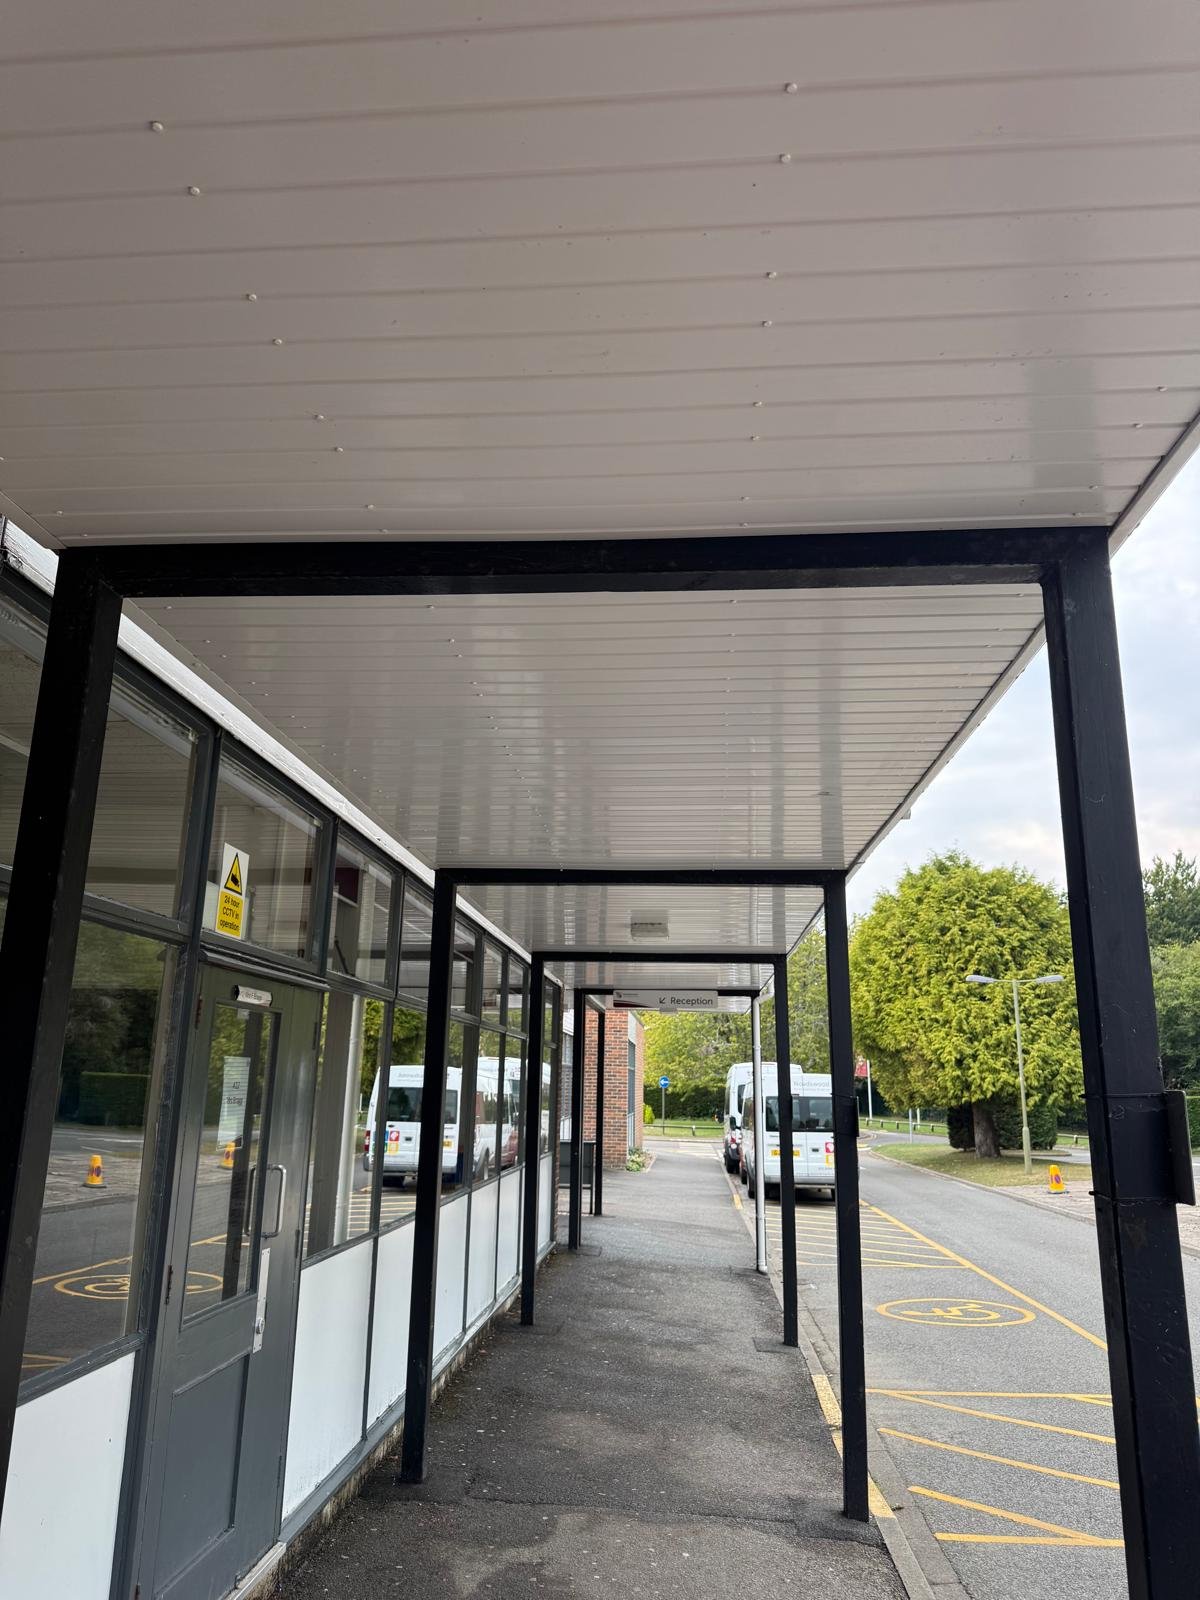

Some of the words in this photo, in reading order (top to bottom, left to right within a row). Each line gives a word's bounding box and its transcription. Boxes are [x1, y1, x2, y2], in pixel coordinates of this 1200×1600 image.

[224, 895, 230, 904] 24
[231, 897, 240, 908] hour
[223, 906, 235, 918] CCTV
[219, 919, 240, 932] operation
[670, 997, 713, 1006] Reception
